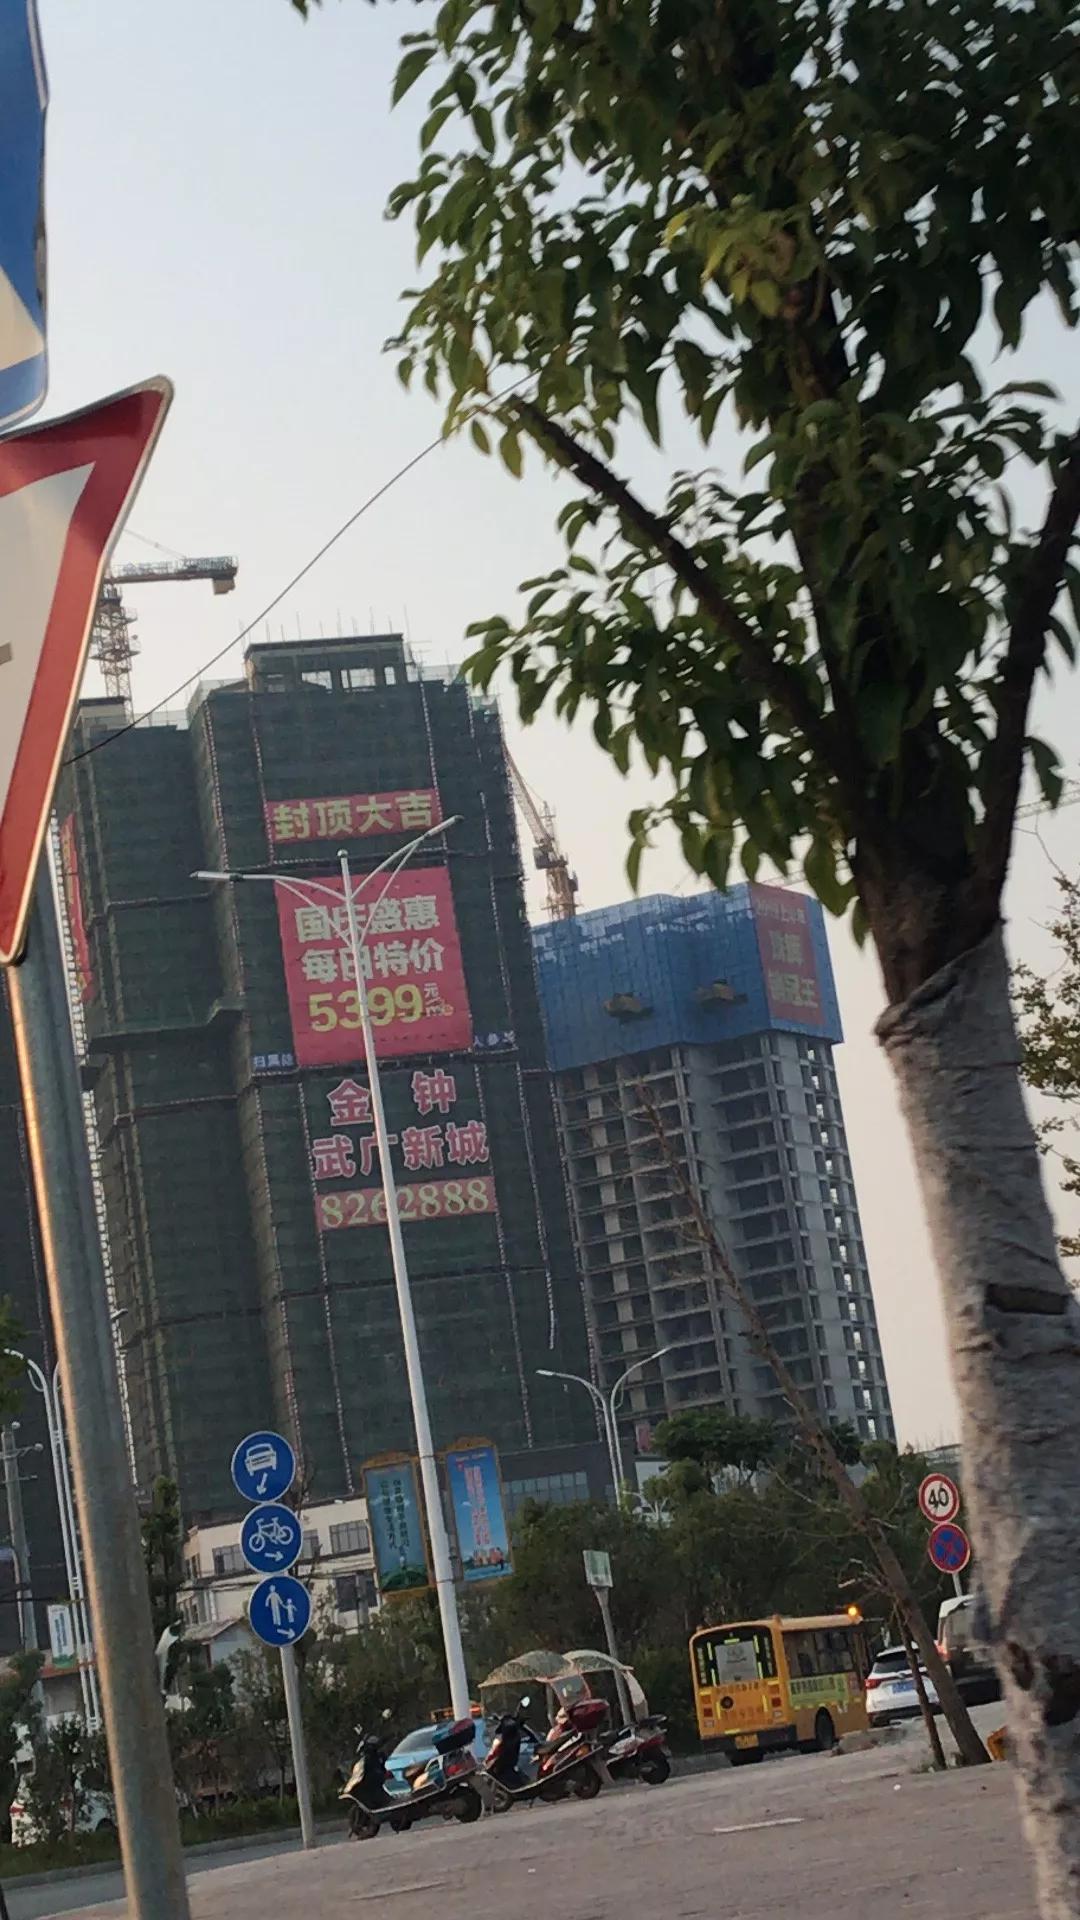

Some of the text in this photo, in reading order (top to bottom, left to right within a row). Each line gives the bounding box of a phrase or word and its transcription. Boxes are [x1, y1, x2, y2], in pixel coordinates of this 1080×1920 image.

[273, 791, 433, 840] 封顶大吉
[294, 894, 440, 944] 国庆盛惠
[301, 937, 445, 983] 每日特价
[308, 983, 424, 1032] 5399
[312, 1119, 490, 1179] 武广新城
[320, 1179, 489, 1228] 8262888
[928, 1486, 949, 1508] 40
